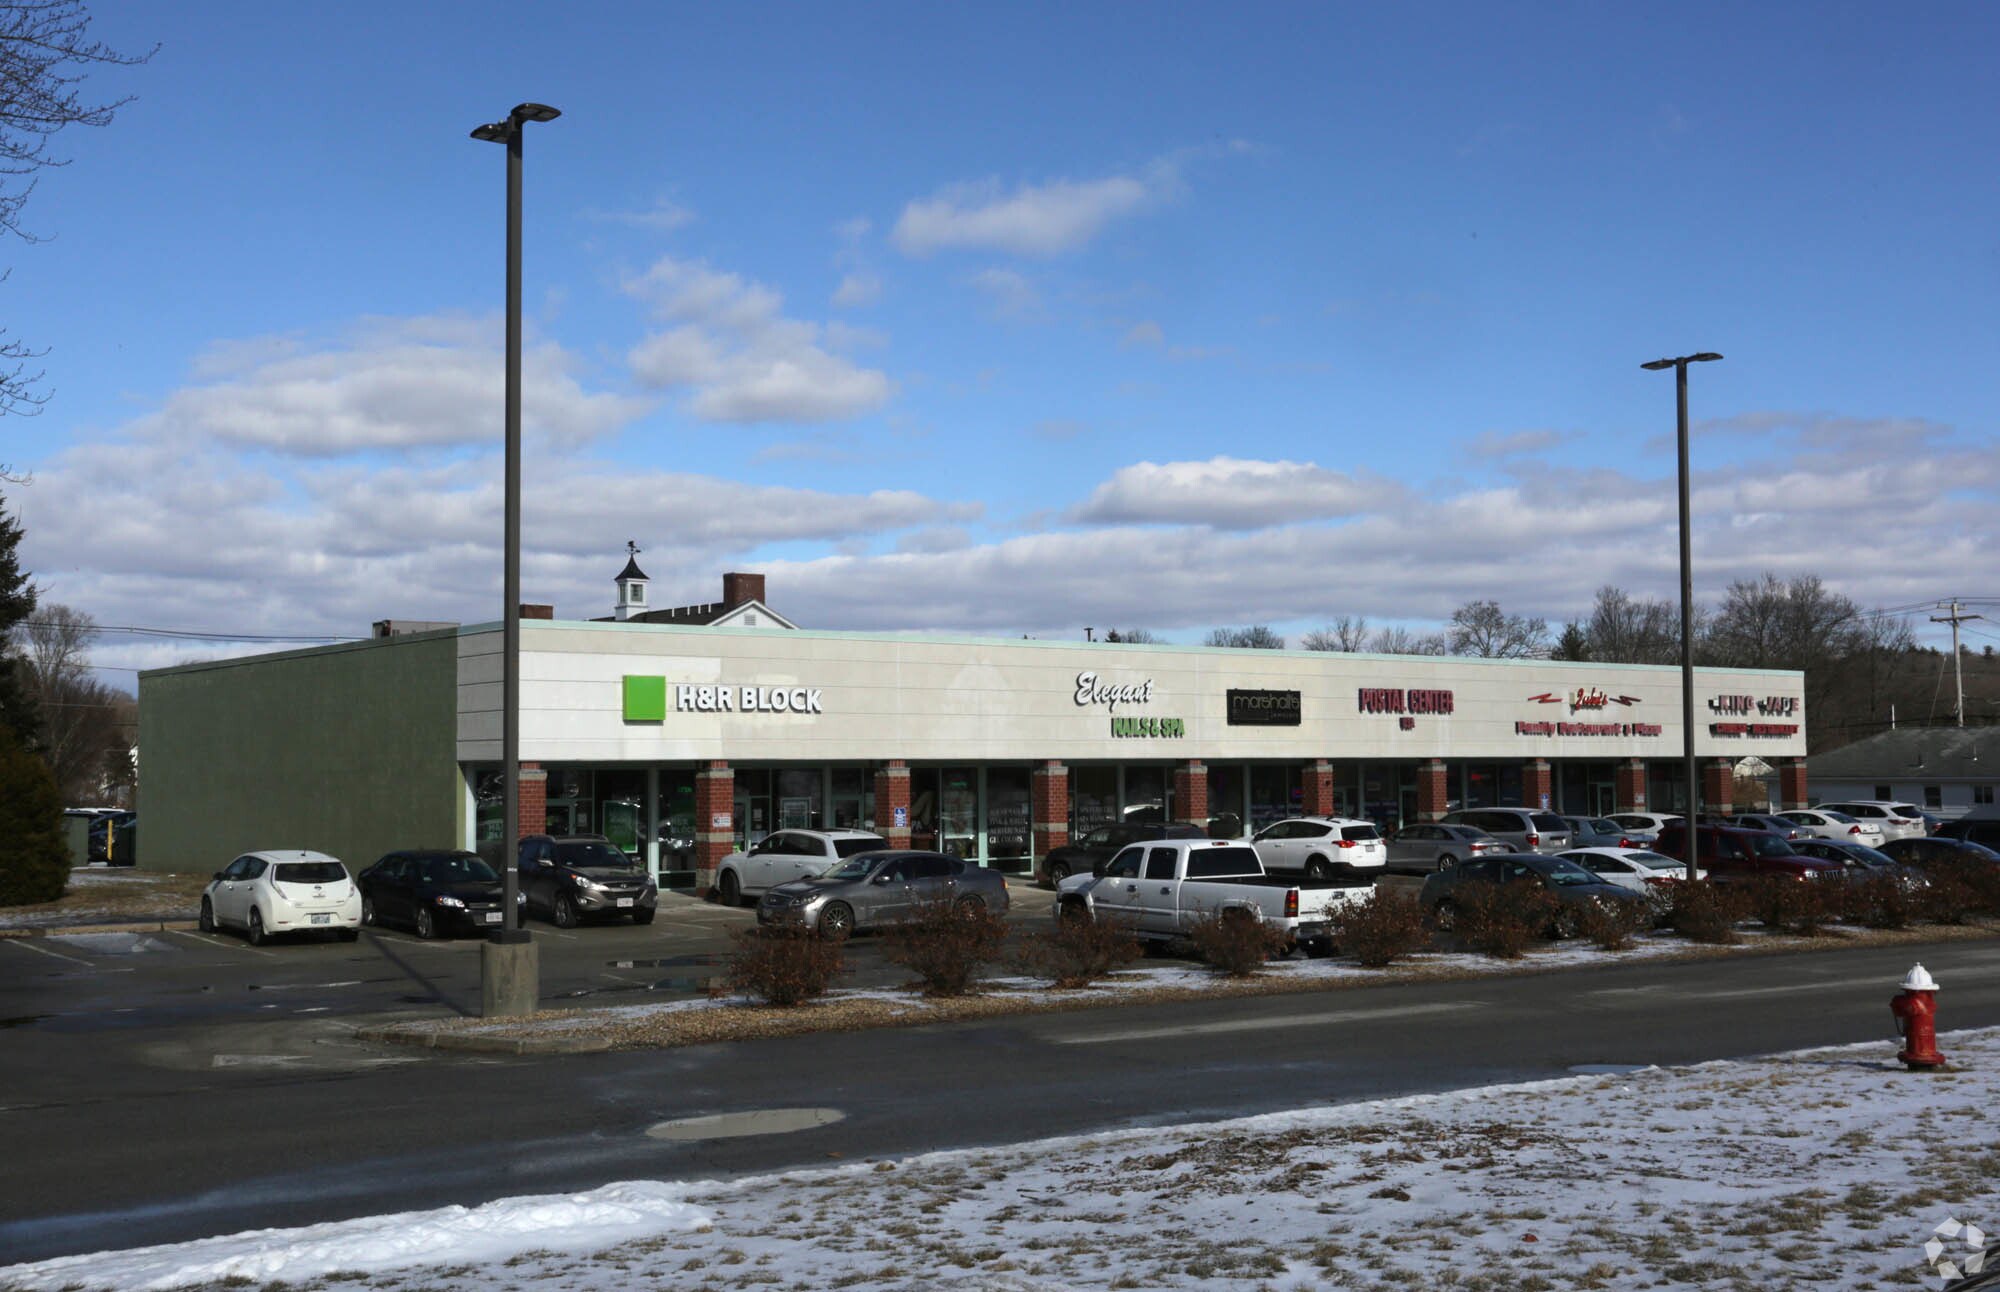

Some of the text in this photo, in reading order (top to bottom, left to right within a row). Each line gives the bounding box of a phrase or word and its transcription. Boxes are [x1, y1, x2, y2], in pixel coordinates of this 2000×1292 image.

[677, 685, 822, 713] H&R BLOCK
[1075, 671, 1154, 713] Elegant
[1359, 688, 1454, 714] POSTAL CENTER
[1713, 695, 1799, 714] KING JADE
[1111, 717, 1185, 738] NAILS & SPA
[1515, 721, 1555, 737] Family
